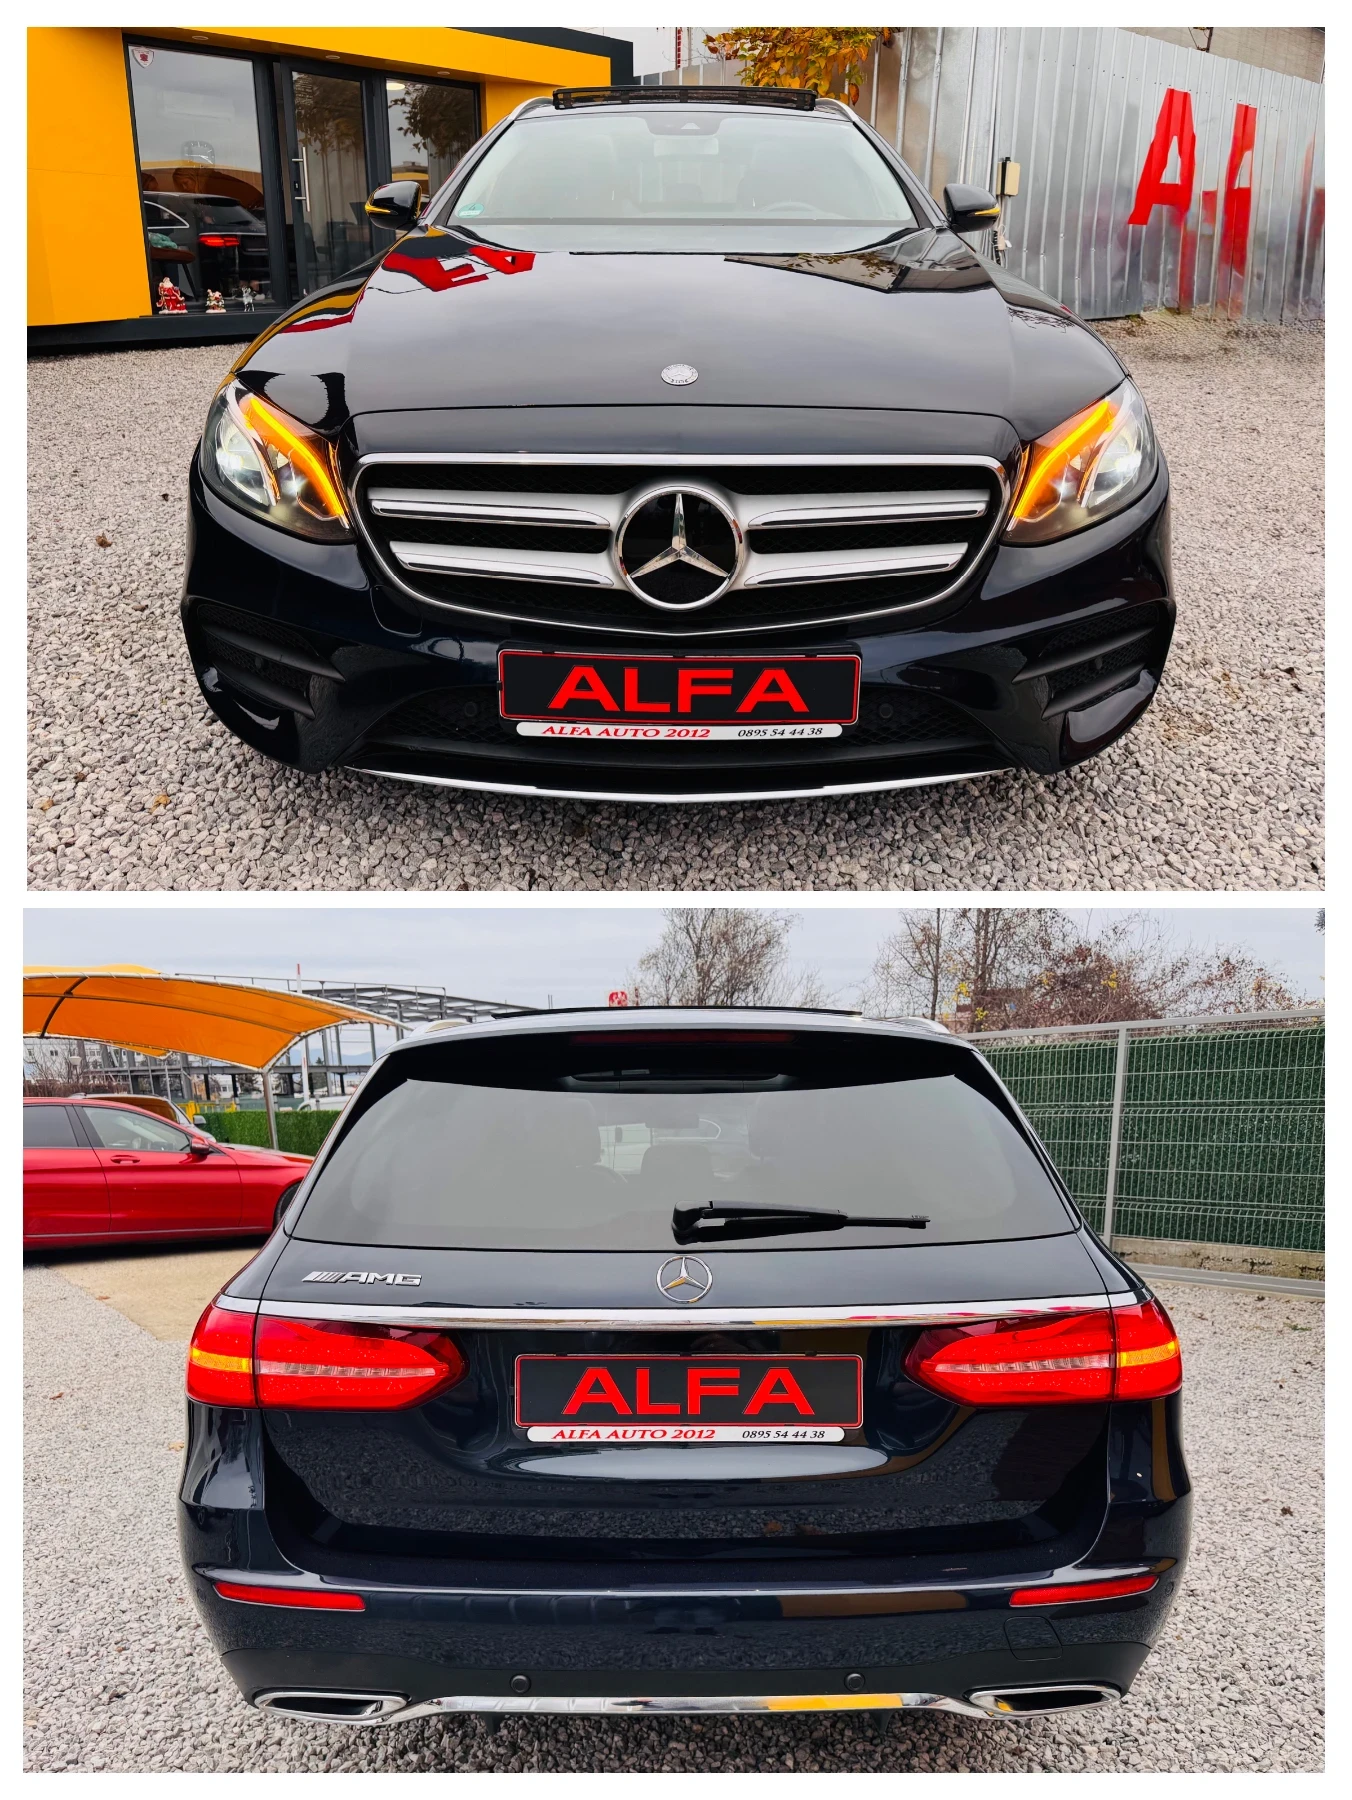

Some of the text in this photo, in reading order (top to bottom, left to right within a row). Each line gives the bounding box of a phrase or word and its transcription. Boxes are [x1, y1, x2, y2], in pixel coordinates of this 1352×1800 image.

[547, 664, 810, 713] ALFA
[541, 725, 823, 738] ALFA AUTO 2012 0895 54 44 38
[562, 1366, 816, 1416] ALFA
[552, 1429, 826, 1440] ALFA AUTO 2012 0895 54 44 38
